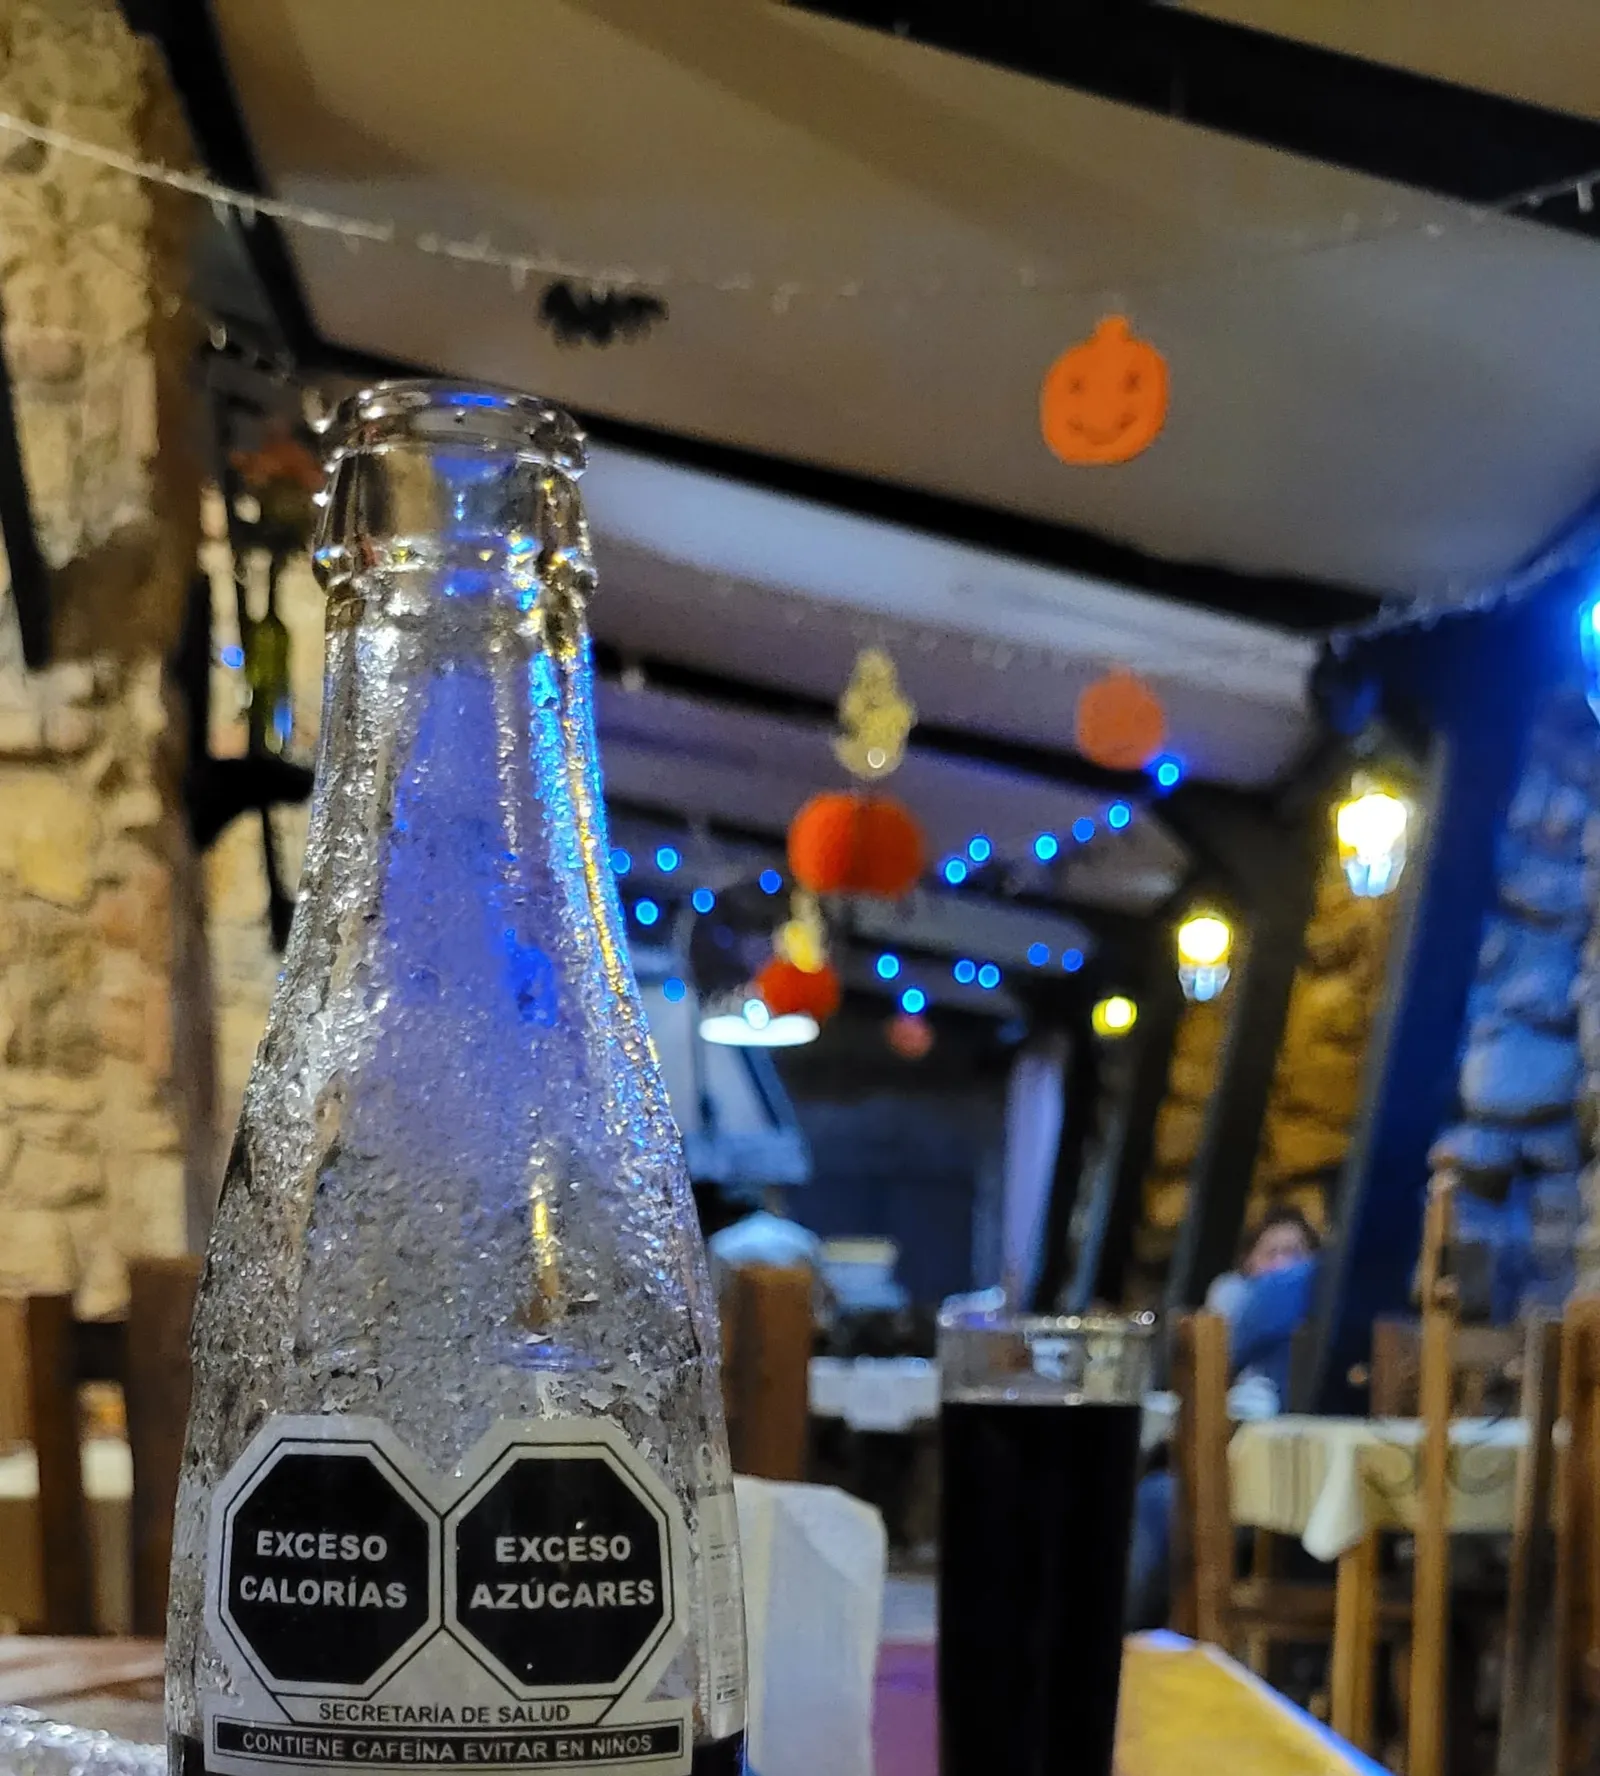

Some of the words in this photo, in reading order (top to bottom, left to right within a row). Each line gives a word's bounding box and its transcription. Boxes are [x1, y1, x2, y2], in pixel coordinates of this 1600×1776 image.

[256, 1530, 387, 1561] EXCESO
[495, 1534, 631, 1562] EXCESO
[240, 1575, 407, 1609] CALORÍAS
[470, 1577, 655, 1609] AZÚCARES
[319, 1702, 455, 1724] SECRETARÍA
[461, 1706, 490, 1723] DE
[498, 1704, 570, 1722] SALUD
[243, 1732, 344, 1757] CONTIENE
[353, 1739, 455, 1761] CAFEÍNA
[464, 1741, 548, 1760] EVITAR
[556, 1739, 584, 1757] EN
